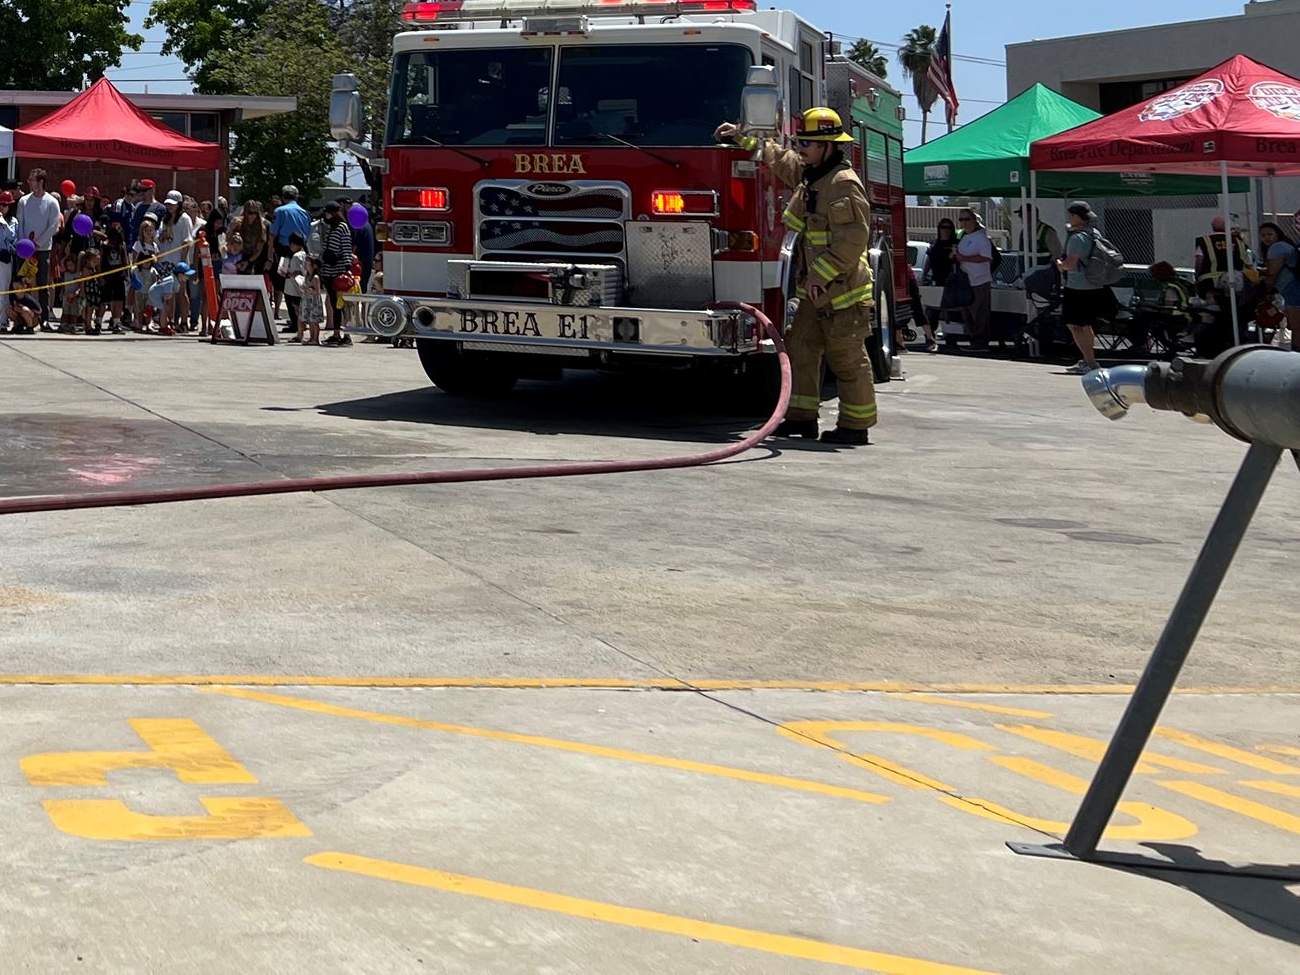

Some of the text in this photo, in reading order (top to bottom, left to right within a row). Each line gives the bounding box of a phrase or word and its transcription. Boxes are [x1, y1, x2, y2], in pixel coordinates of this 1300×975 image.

[113, 141, 175, 158] Department
[1256, 136, 1297, 154] Brea
[514, 153, 587, 174] BREA
[531, 184, 566, 193] Pierce
[223, 298, 254, 310] OPEN
[459, 309, 590, 340] BREA E1
